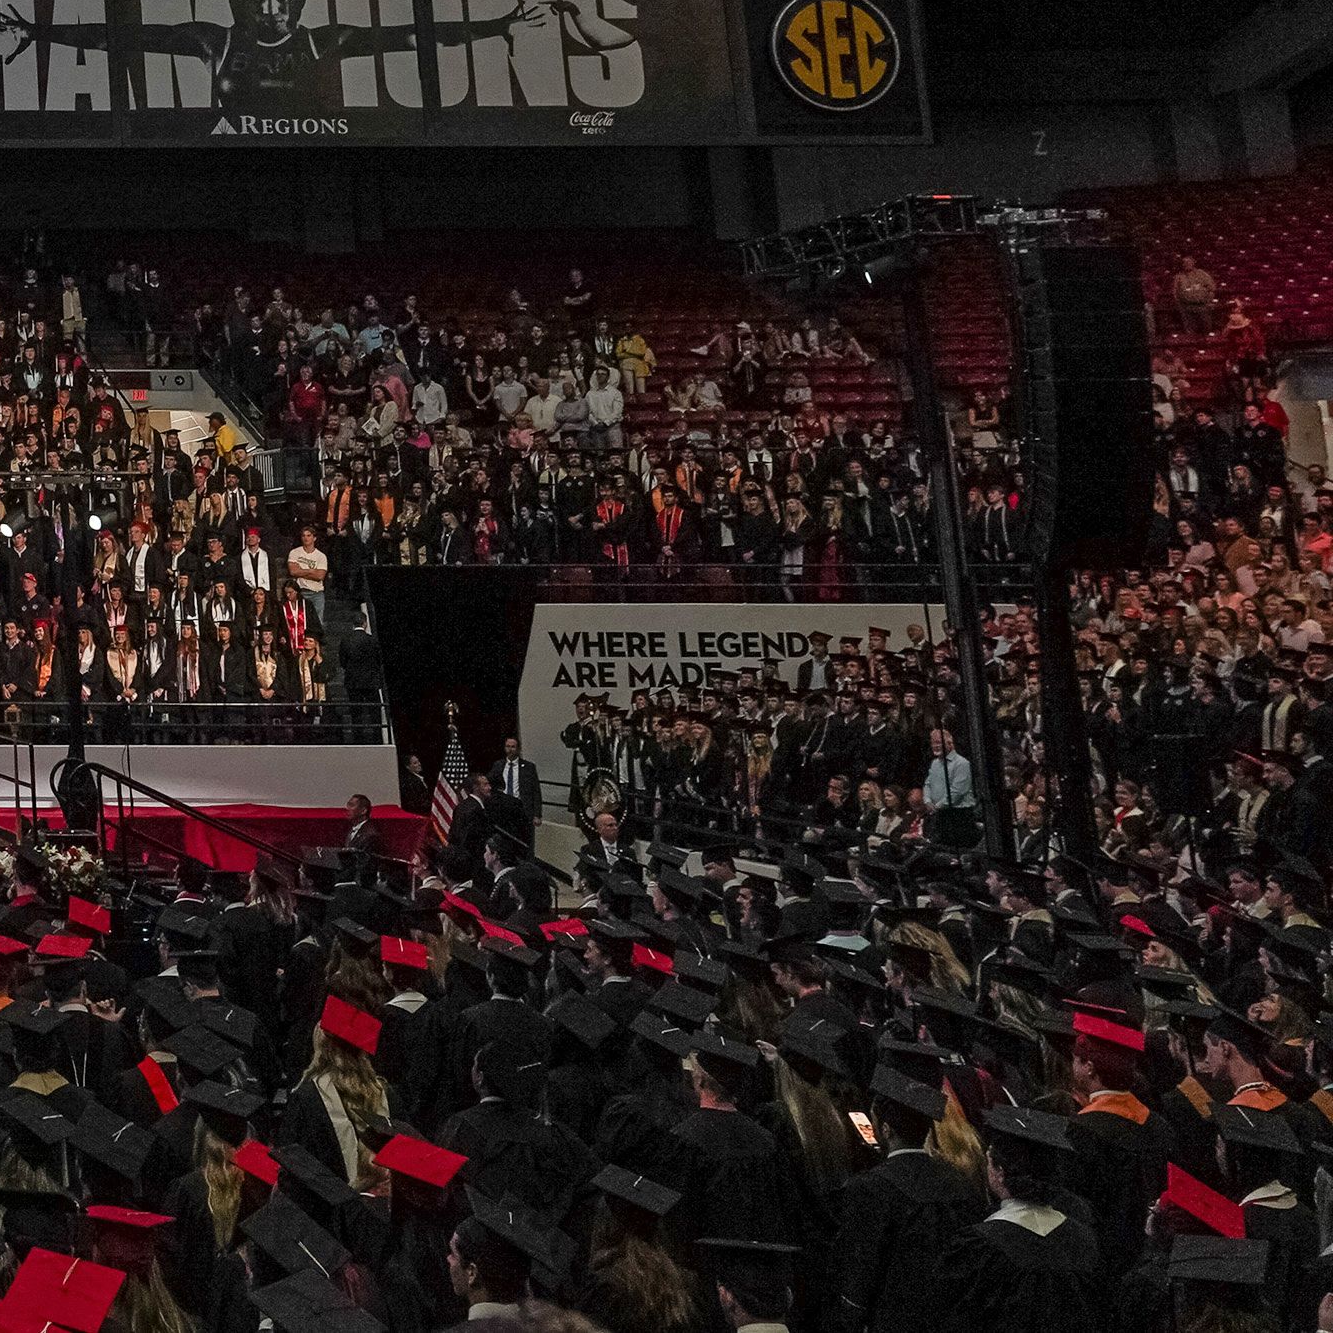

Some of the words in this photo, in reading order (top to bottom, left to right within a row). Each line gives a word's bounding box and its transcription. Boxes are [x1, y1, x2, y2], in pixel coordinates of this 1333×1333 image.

[786, 0, 887, 100] SEC
[239, 113, 348, 136] REGIONS
[569, 111, 615, 127] Coca-Cola
[159, 375, 168, 386] Y
[548, 631, 668, 657] WHERE
[678, 631, 810, 658] LEGEND
[552, 662, 617, 688] ARE
